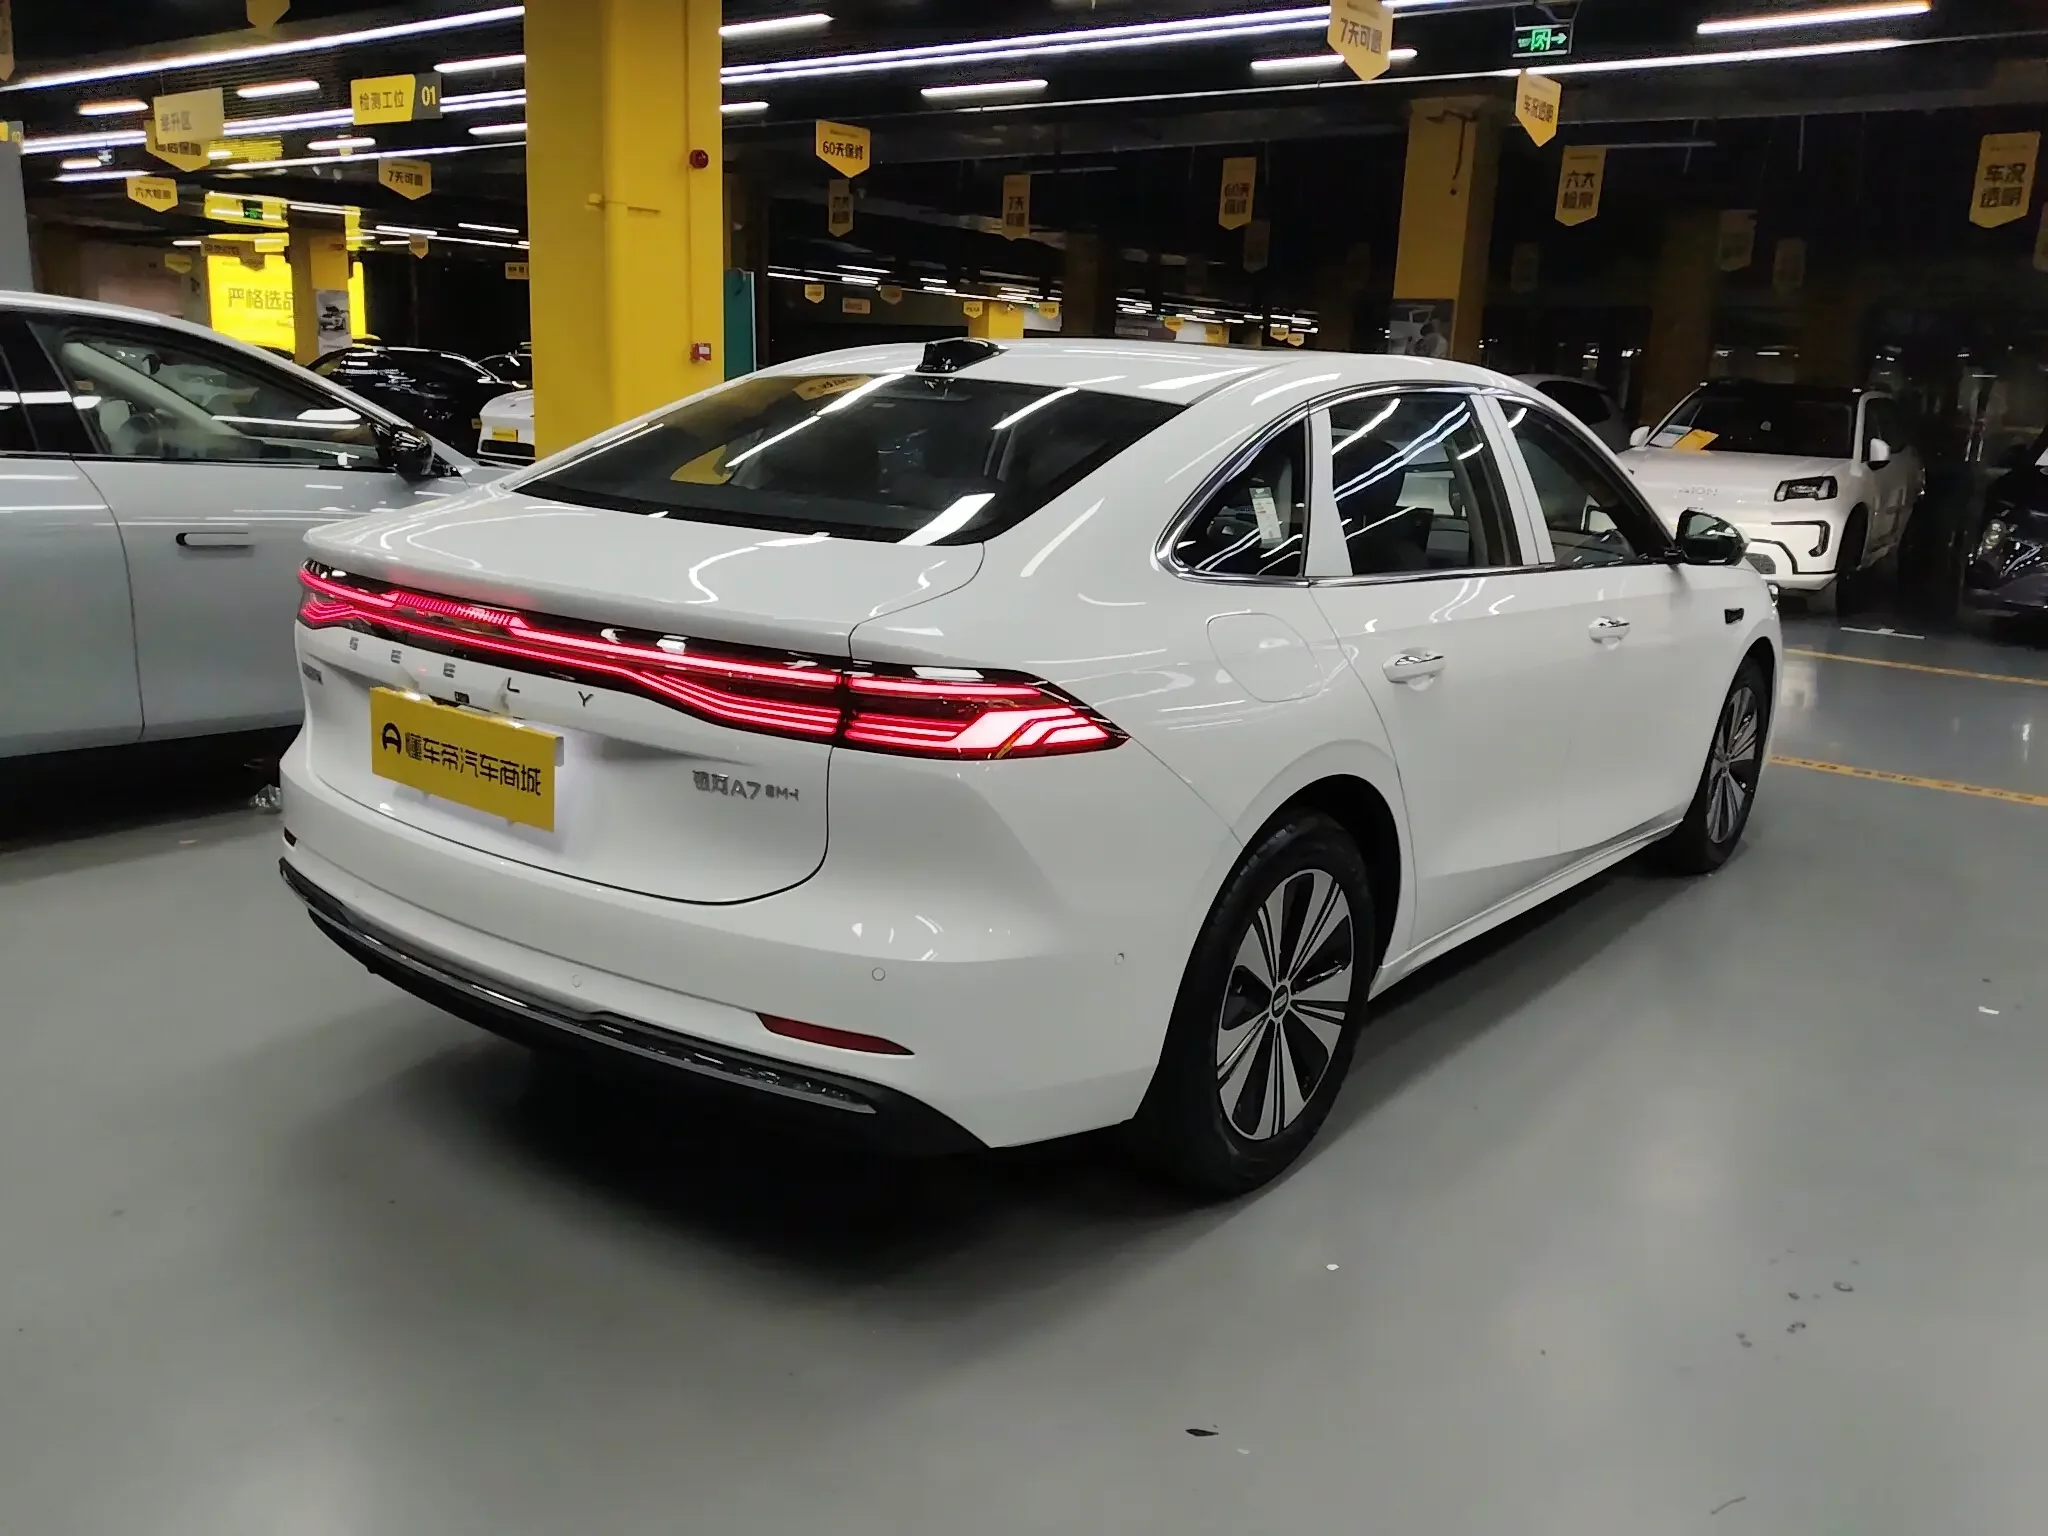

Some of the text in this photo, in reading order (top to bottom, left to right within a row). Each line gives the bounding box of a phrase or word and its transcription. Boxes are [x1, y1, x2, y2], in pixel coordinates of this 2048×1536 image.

[359, 86, 436, 111] 检测工位 01
[349, 636, 594, 708] GEELY
